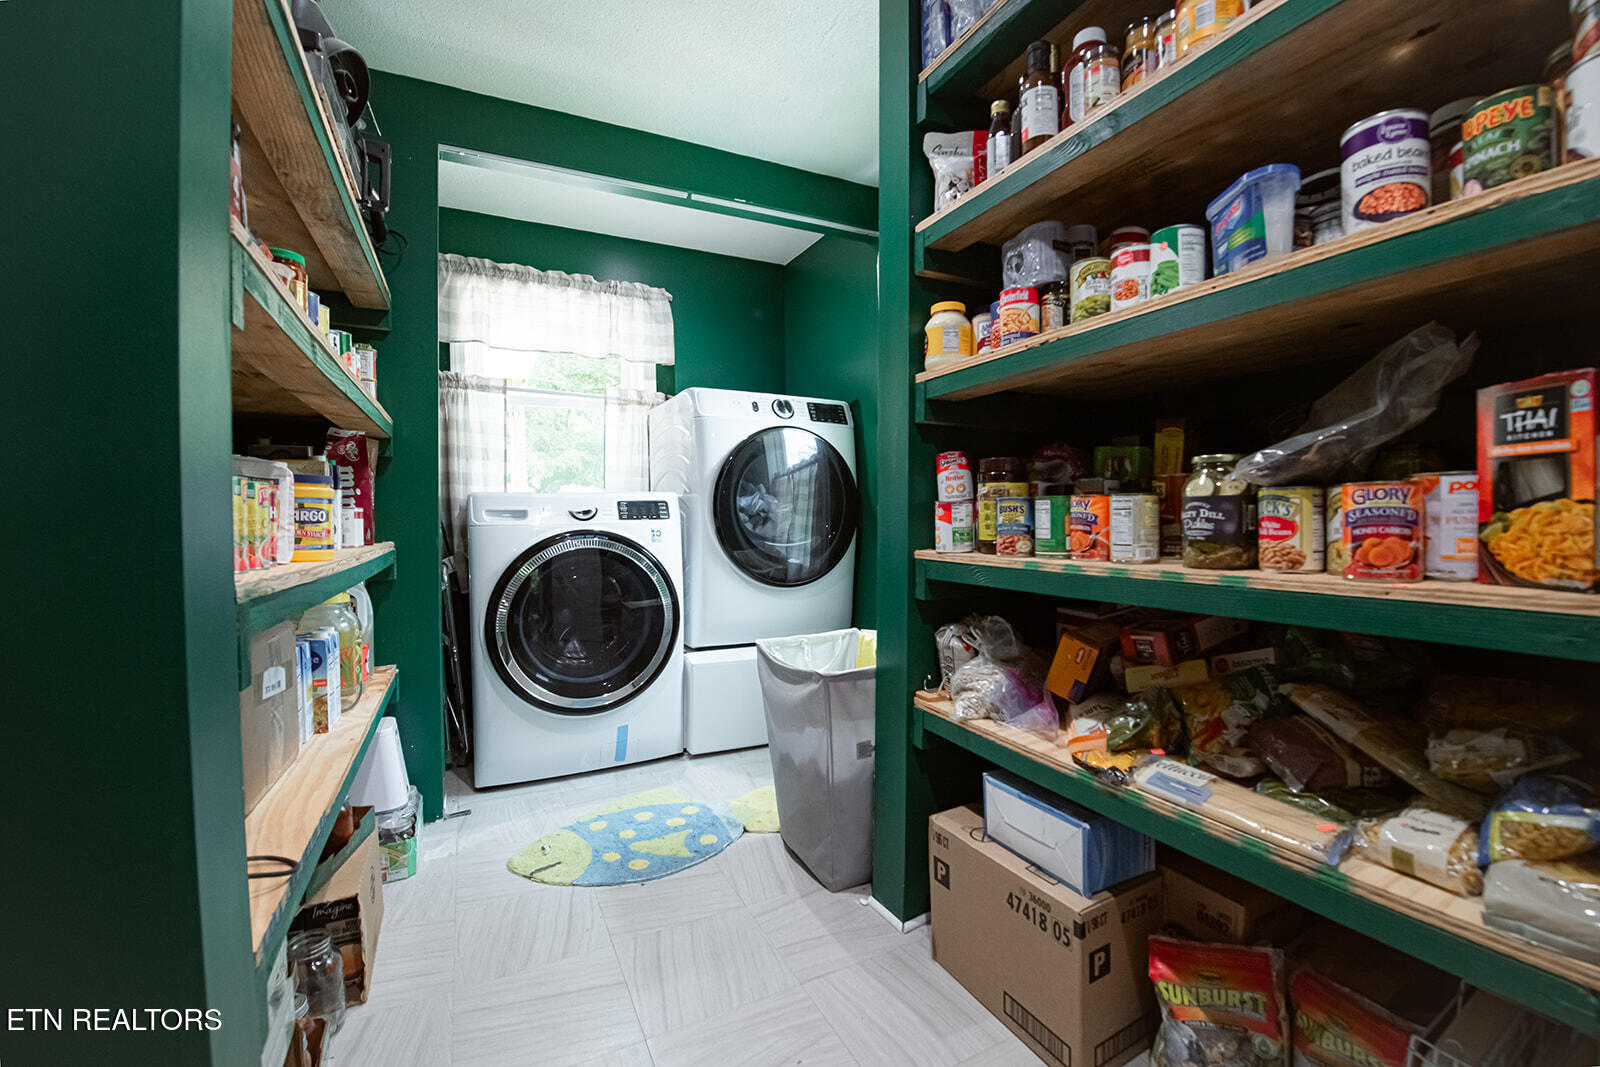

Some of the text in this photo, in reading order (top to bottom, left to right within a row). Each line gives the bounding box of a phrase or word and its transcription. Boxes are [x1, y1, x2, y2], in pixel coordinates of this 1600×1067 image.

[1499, 407, 1558, 432] THAI
[1352, 487, 1412, 505] GLORY
[999, 505, 1025, 514] BUSH'S
[1347, 508, 1417, 522] SEASONED
[1006, 891, 1071, 947] 47418 05
[1157, 981, 1267, 1014] SUNBURST
